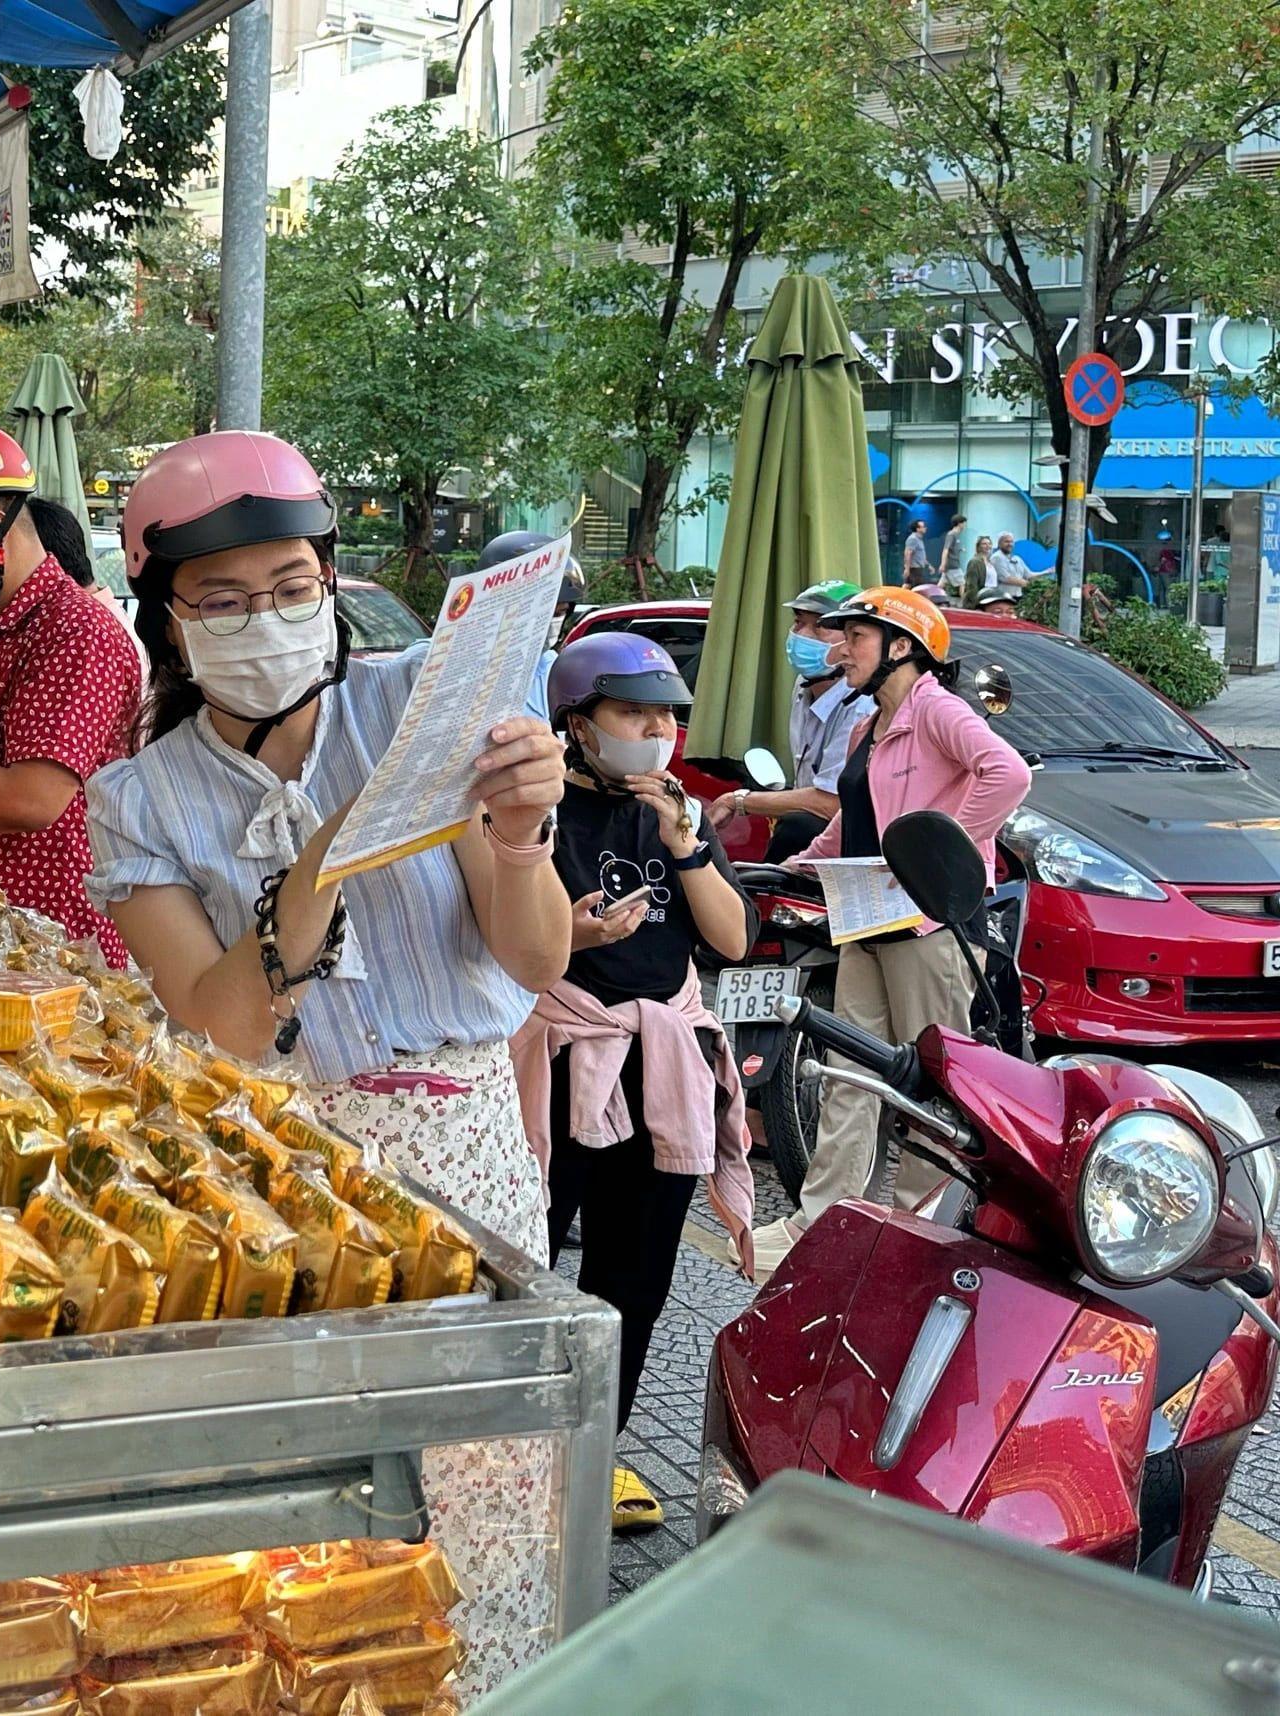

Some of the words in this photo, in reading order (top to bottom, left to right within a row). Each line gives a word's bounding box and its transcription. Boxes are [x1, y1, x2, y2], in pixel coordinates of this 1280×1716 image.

[1111, 441, 1154, 457] KET
[1157, 441, 1170, 457] &
[1177, 441, 1280, 457] ETRANC
[483, 563, 522, 591] NHƯ
[522, 551, 552, 576] LAN
[729, 971, 786, 994] 59-C3
[720, 995, 776, 1019] 118.5
[1050, 1368, 1145, 1391] Janus
